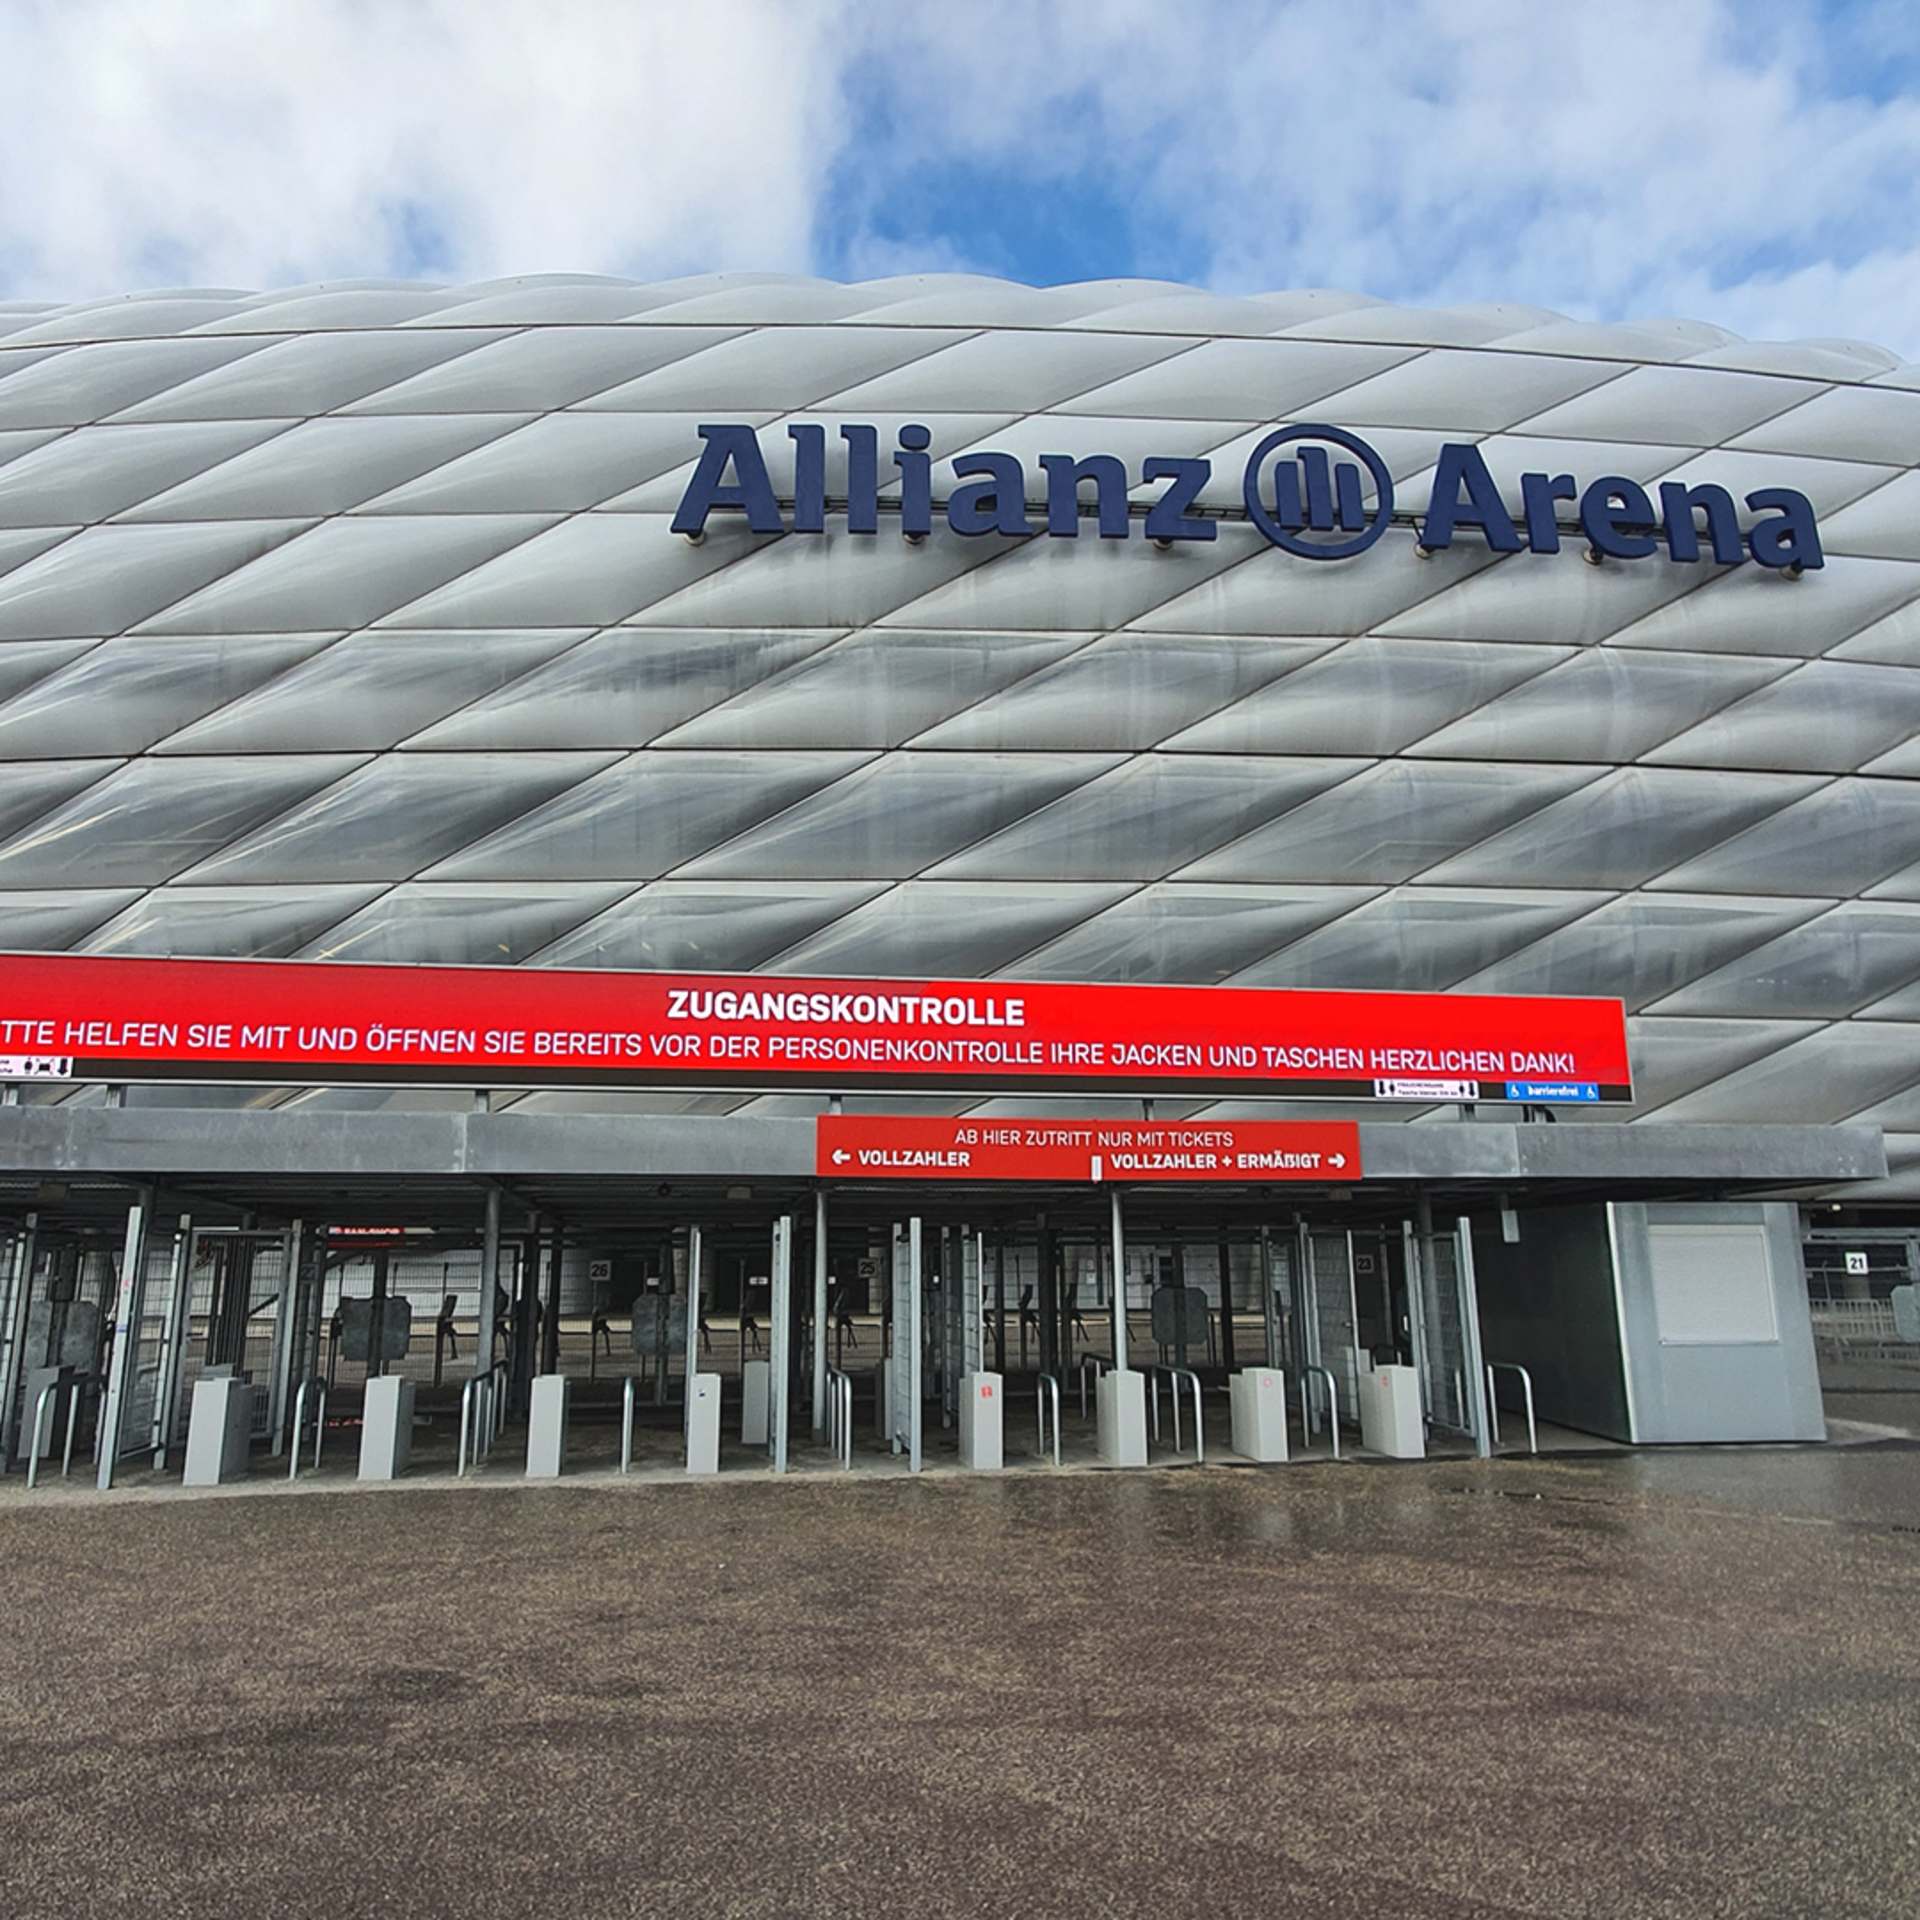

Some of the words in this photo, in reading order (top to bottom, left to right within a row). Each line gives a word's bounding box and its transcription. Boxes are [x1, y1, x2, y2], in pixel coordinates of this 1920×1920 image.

[670, 423, 1217, 541] Allianz
[1422, 442, 1825, 570] Arena
[667, 990, 1025, 1026] ZUGANGSKONTROLLE
[64, 1022, 178, 1046] HELFEN
[187, 1024, 232, 1048] SIE
[241, 1026, 291, 1049] MIT
[298, 1027, 357, 1050] UND
[366, 1024, 475, 1053] ÖFFNEN
[484, 1031, 525, 1054] SIE
[534, 1032, 641, 1056] BEREITS
[649, 1034, 701, 1057] VOR
[710, 1035, 760, 1057] DER
[769, 1037, 1043, 1063] PERSONENKONTROLLE
[1051, 1043, 1104, 1064] IHRE
[1111, 1044, 1201, 1066] JACKEN
[1209, 1046, 1257, 1067] UND
[1262, 1046, 1364, 1069] TASCHEN
[1371, 1049, 1505, 1072] HERZLICHEN
[1511, 1052, 1575, 1073] DANK!
[955, 1129, 978, 1144] AB
[983, 1130, 1021, 1145] HIER
[1026, 1130, 1092, 1146] ZUTRITT
[1098, 1131, 1132, 1146] NUR
[1137, 1131, 1165, 1146] MIT
[1168, 1131, 1234, 1147] TICKETS
[858, 1150, 970, 1167] VOLLZAHLER
[1110, 1153, 1217, 1169] VOLLZAHLER
[1222, 1155, 1233, 1167] +
[591, 1263, 608, 1277] 26
[860, 1261, 875, 1275] 25
[1359, 1257, 1371, 1270] 23
[1850, 1257, 1864, 1270] 21
